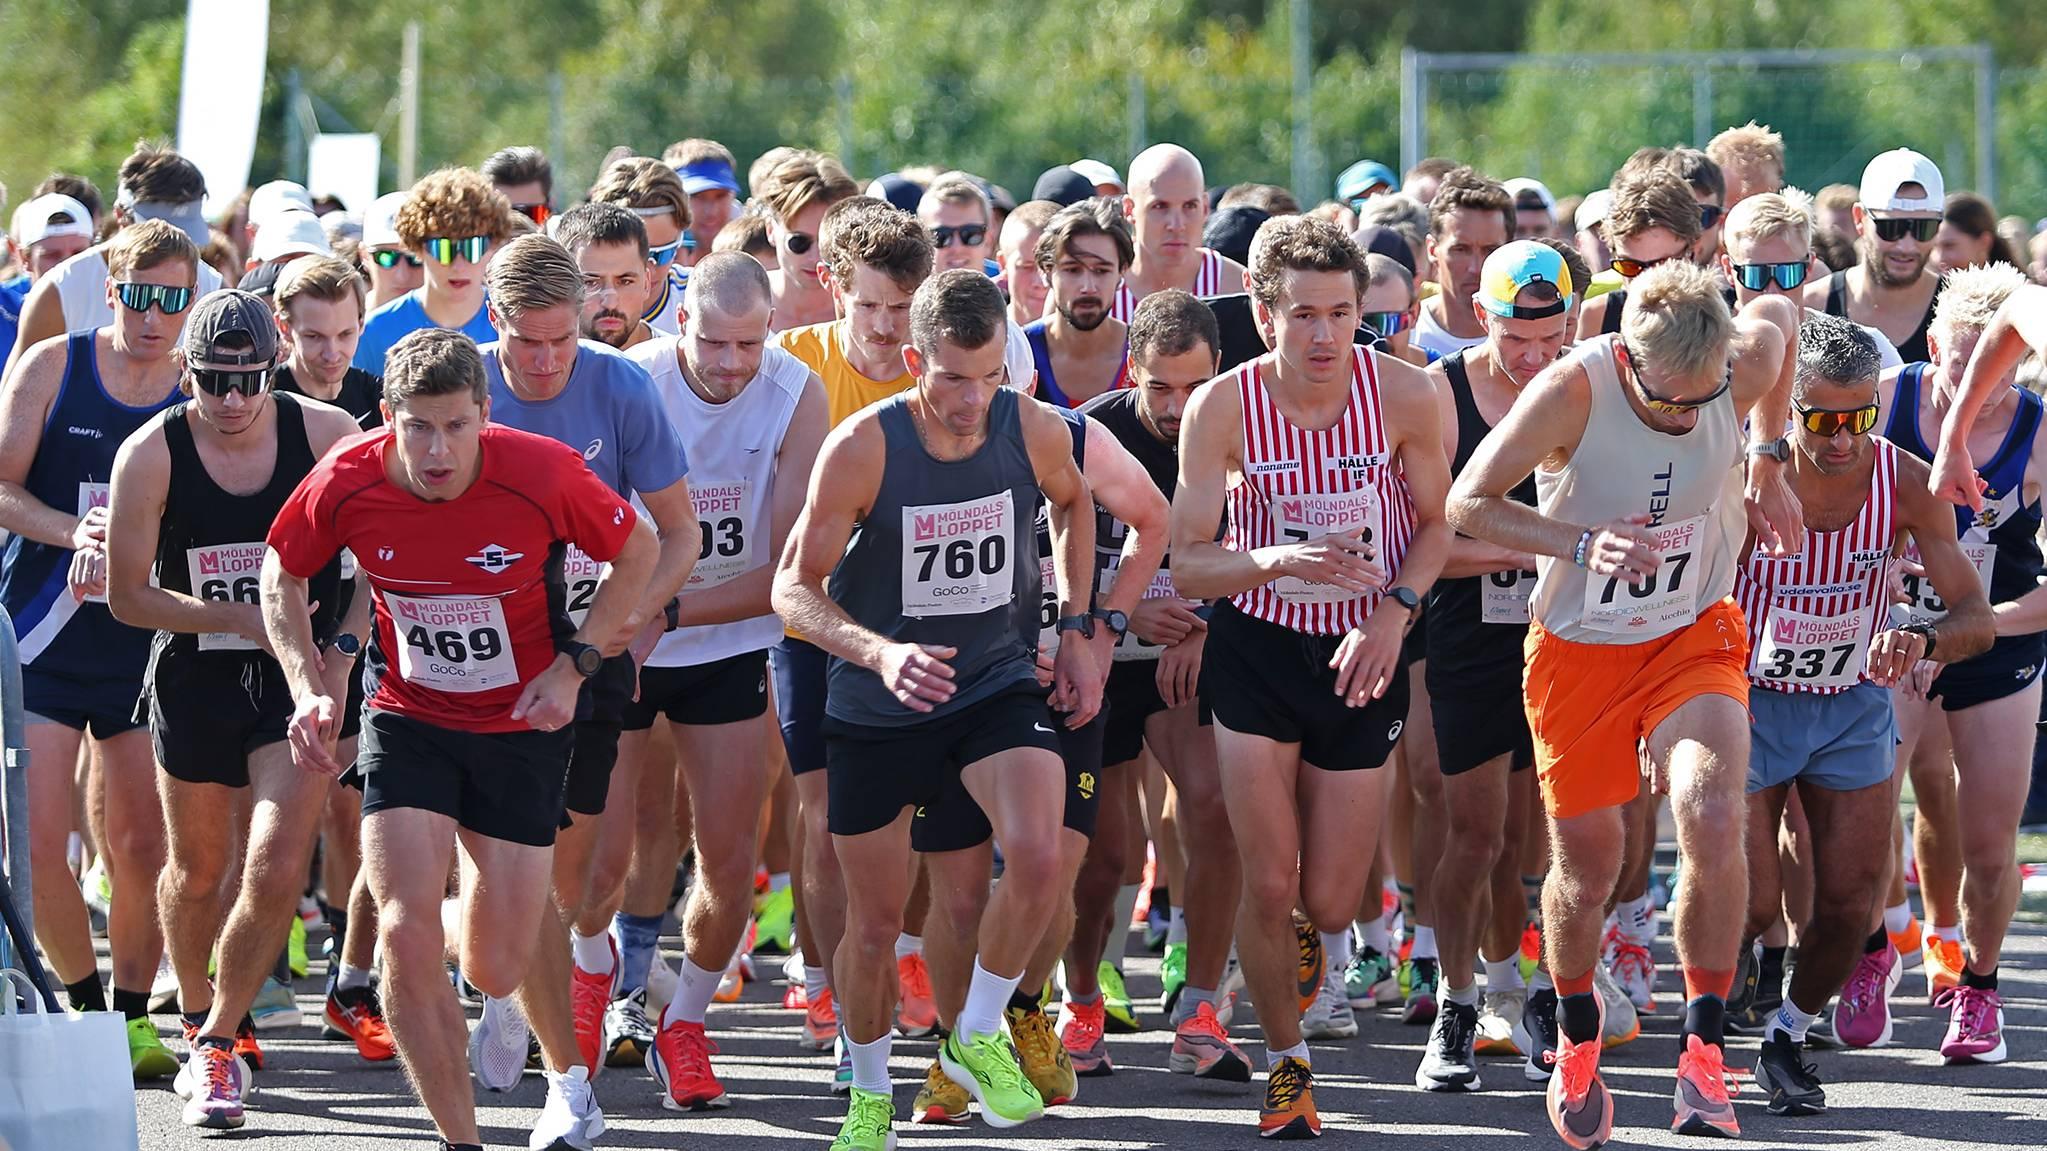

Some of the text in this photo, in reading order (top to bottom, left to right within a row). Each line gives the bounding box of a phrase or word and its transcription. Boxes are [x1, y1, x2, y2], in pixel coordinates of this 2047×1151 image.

[68, 425, 96, 437] CRAFT
[1256, 461, 1300, 472] noname
[1338, 455, 1378, 469] HÄLLE
[1353, 470, 1365, 480] IF
[1304, 494, 1369, 512] MÖLNDALS
[1305, 506, 1369, 526] LOPPET
[938, 513, 1004, 538] LOPPET
[913, 535, 1006, 583] 760
[1864, 562, 1877, 570] IF
[932, 586, 969, 597] GoCo
[1780, 584, 1862, 595] uddevalla.se
[418, 600, 490, 614] MÖLNDALS
[421, 610, 491, 626] LOPPET
[1799, 616, 1860, 632] MÖLNDALS
[1796, 627, 1859, 644] LOPPET
[407, 624, 502, 663] 469
[1764, 643, 1856, 678] 337
[430, 663, 466, 677] GoCo
